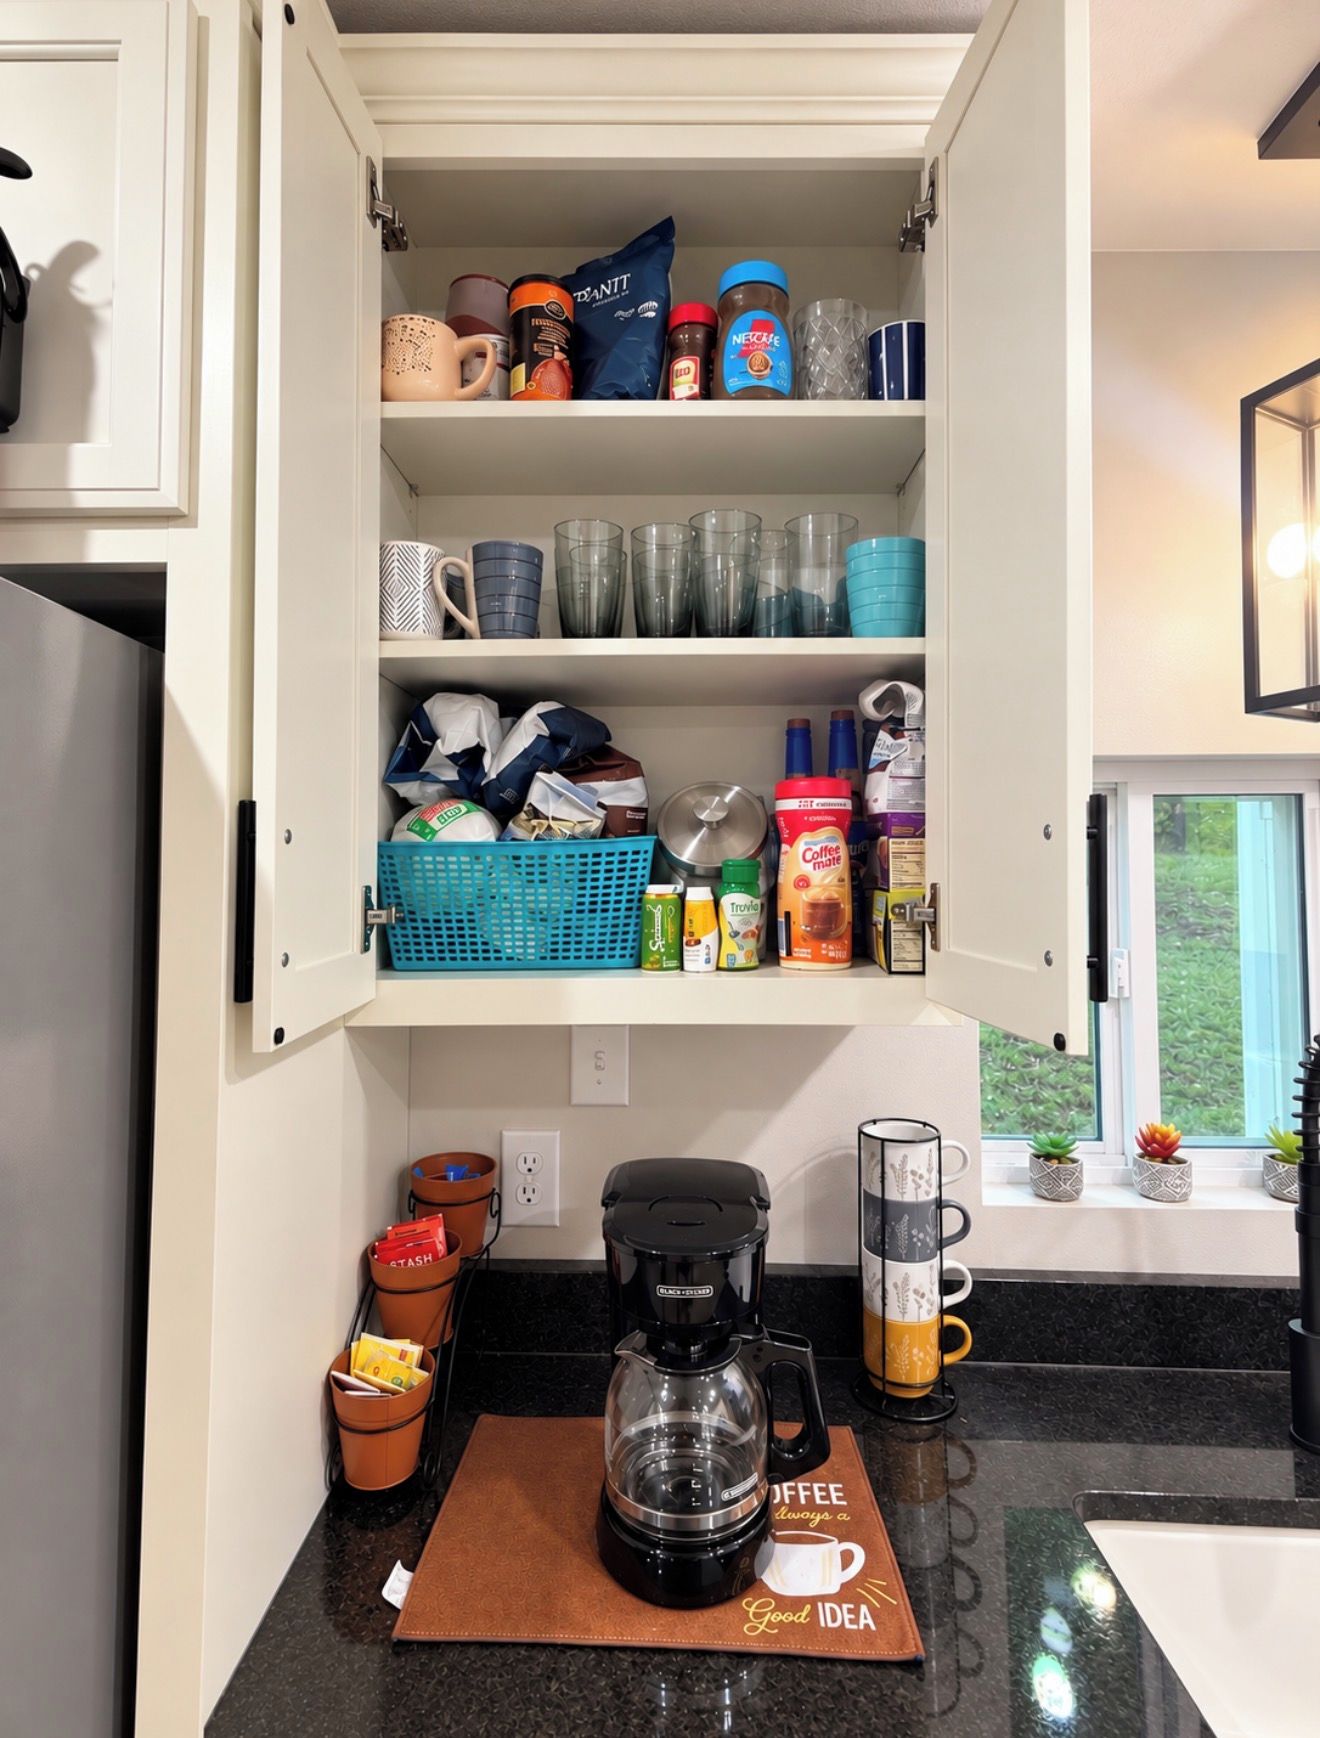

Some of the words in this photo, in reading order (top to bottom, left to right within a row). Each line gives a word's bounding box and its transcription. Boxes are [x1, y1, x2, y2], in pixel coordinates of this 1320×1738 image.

[802, 845, 841, 864] Coffee
[813, 855, 842, 871] mate
[390, 1253, 433, 1268] STASH
[772, 1482, 847, 1505] FFEE
[775, 1506, 833, 1528] lways
[836, 1512, 851, 1521] a
[742, 1597, 811, 1636] Good
[817, 1602, 877, 1631] IDEA
